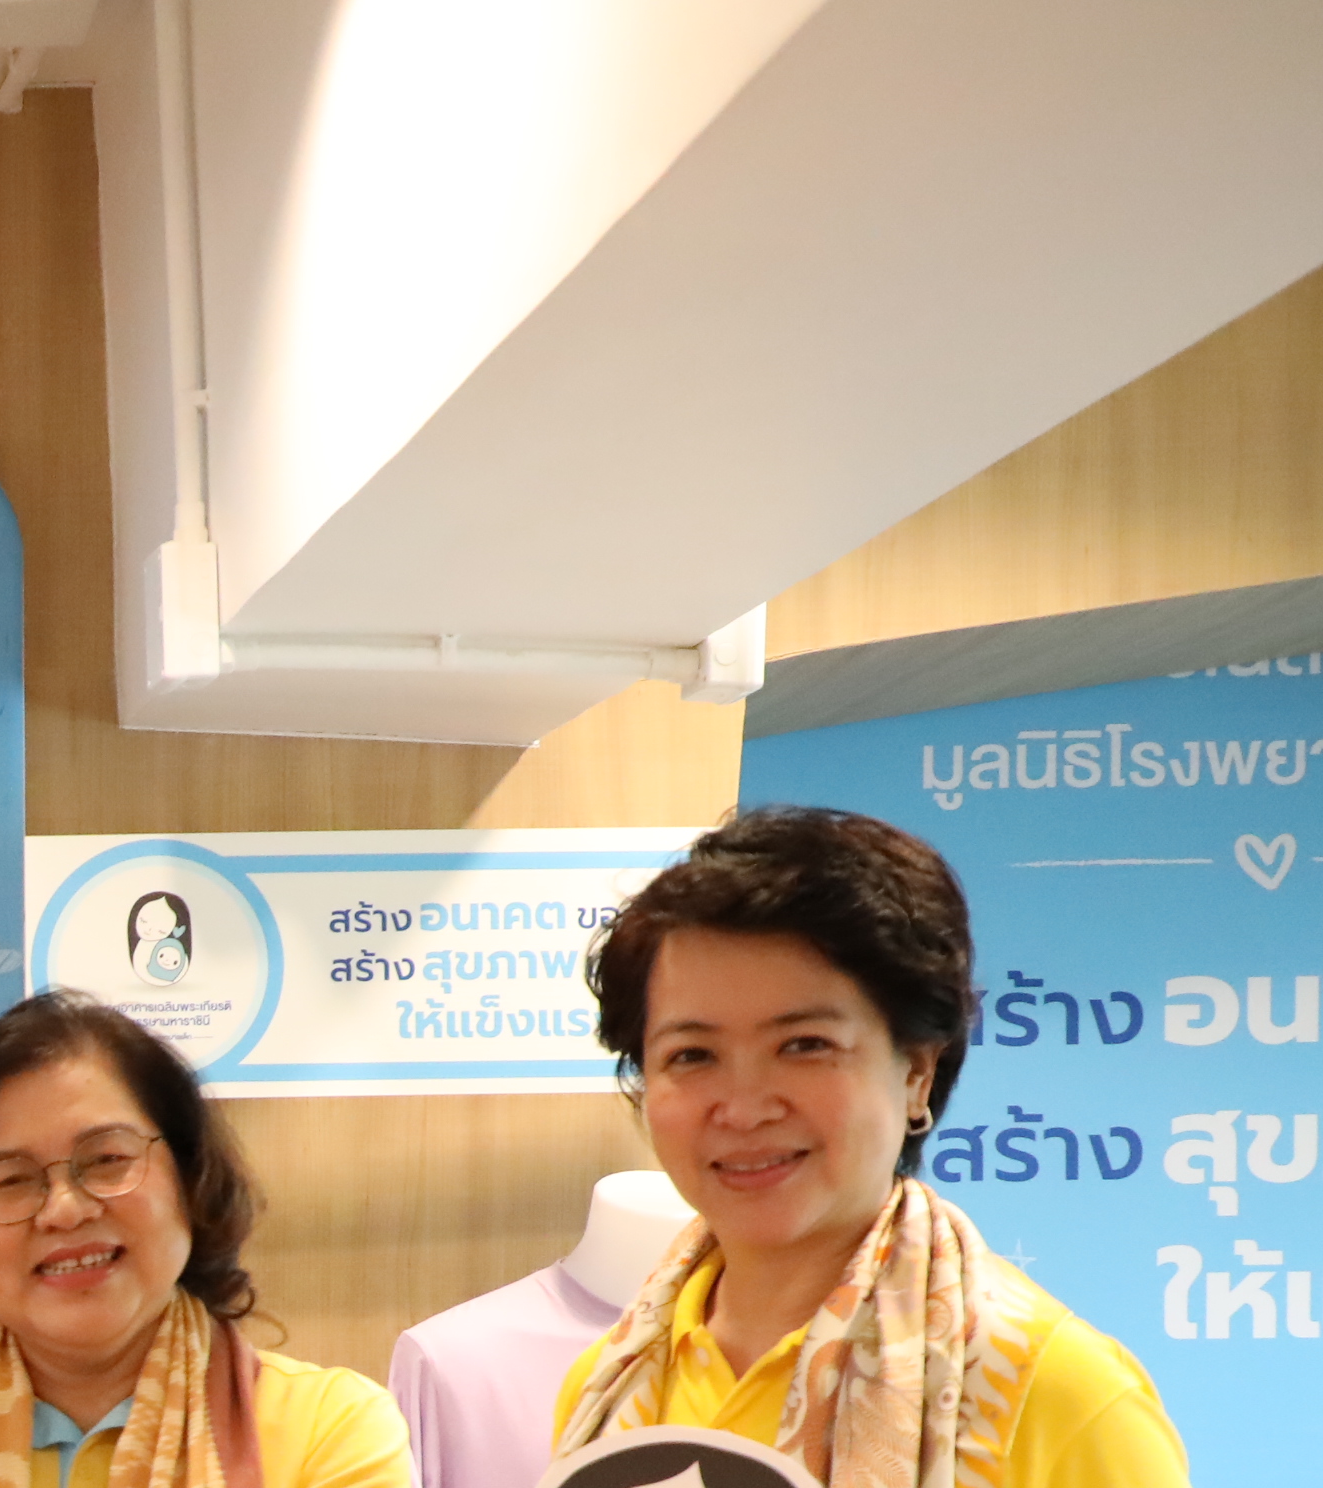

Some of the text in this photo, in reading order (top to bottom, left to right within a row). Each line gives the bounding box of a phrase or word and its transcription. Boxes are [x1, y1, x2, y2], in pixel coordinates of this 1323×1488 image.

[921, 723, 1323, 811] มูลนิธิโรงพย
[329, 901, 412, 933] สร้าง
[420, 901, 566, 932] อนาคต
[330, 949, 579, 994] สร้าง สุขภาพ
[396, 994, 602, 1040] ให้แข็งแร
[931, 1105, 1319, 1217] สร้าง สุข
